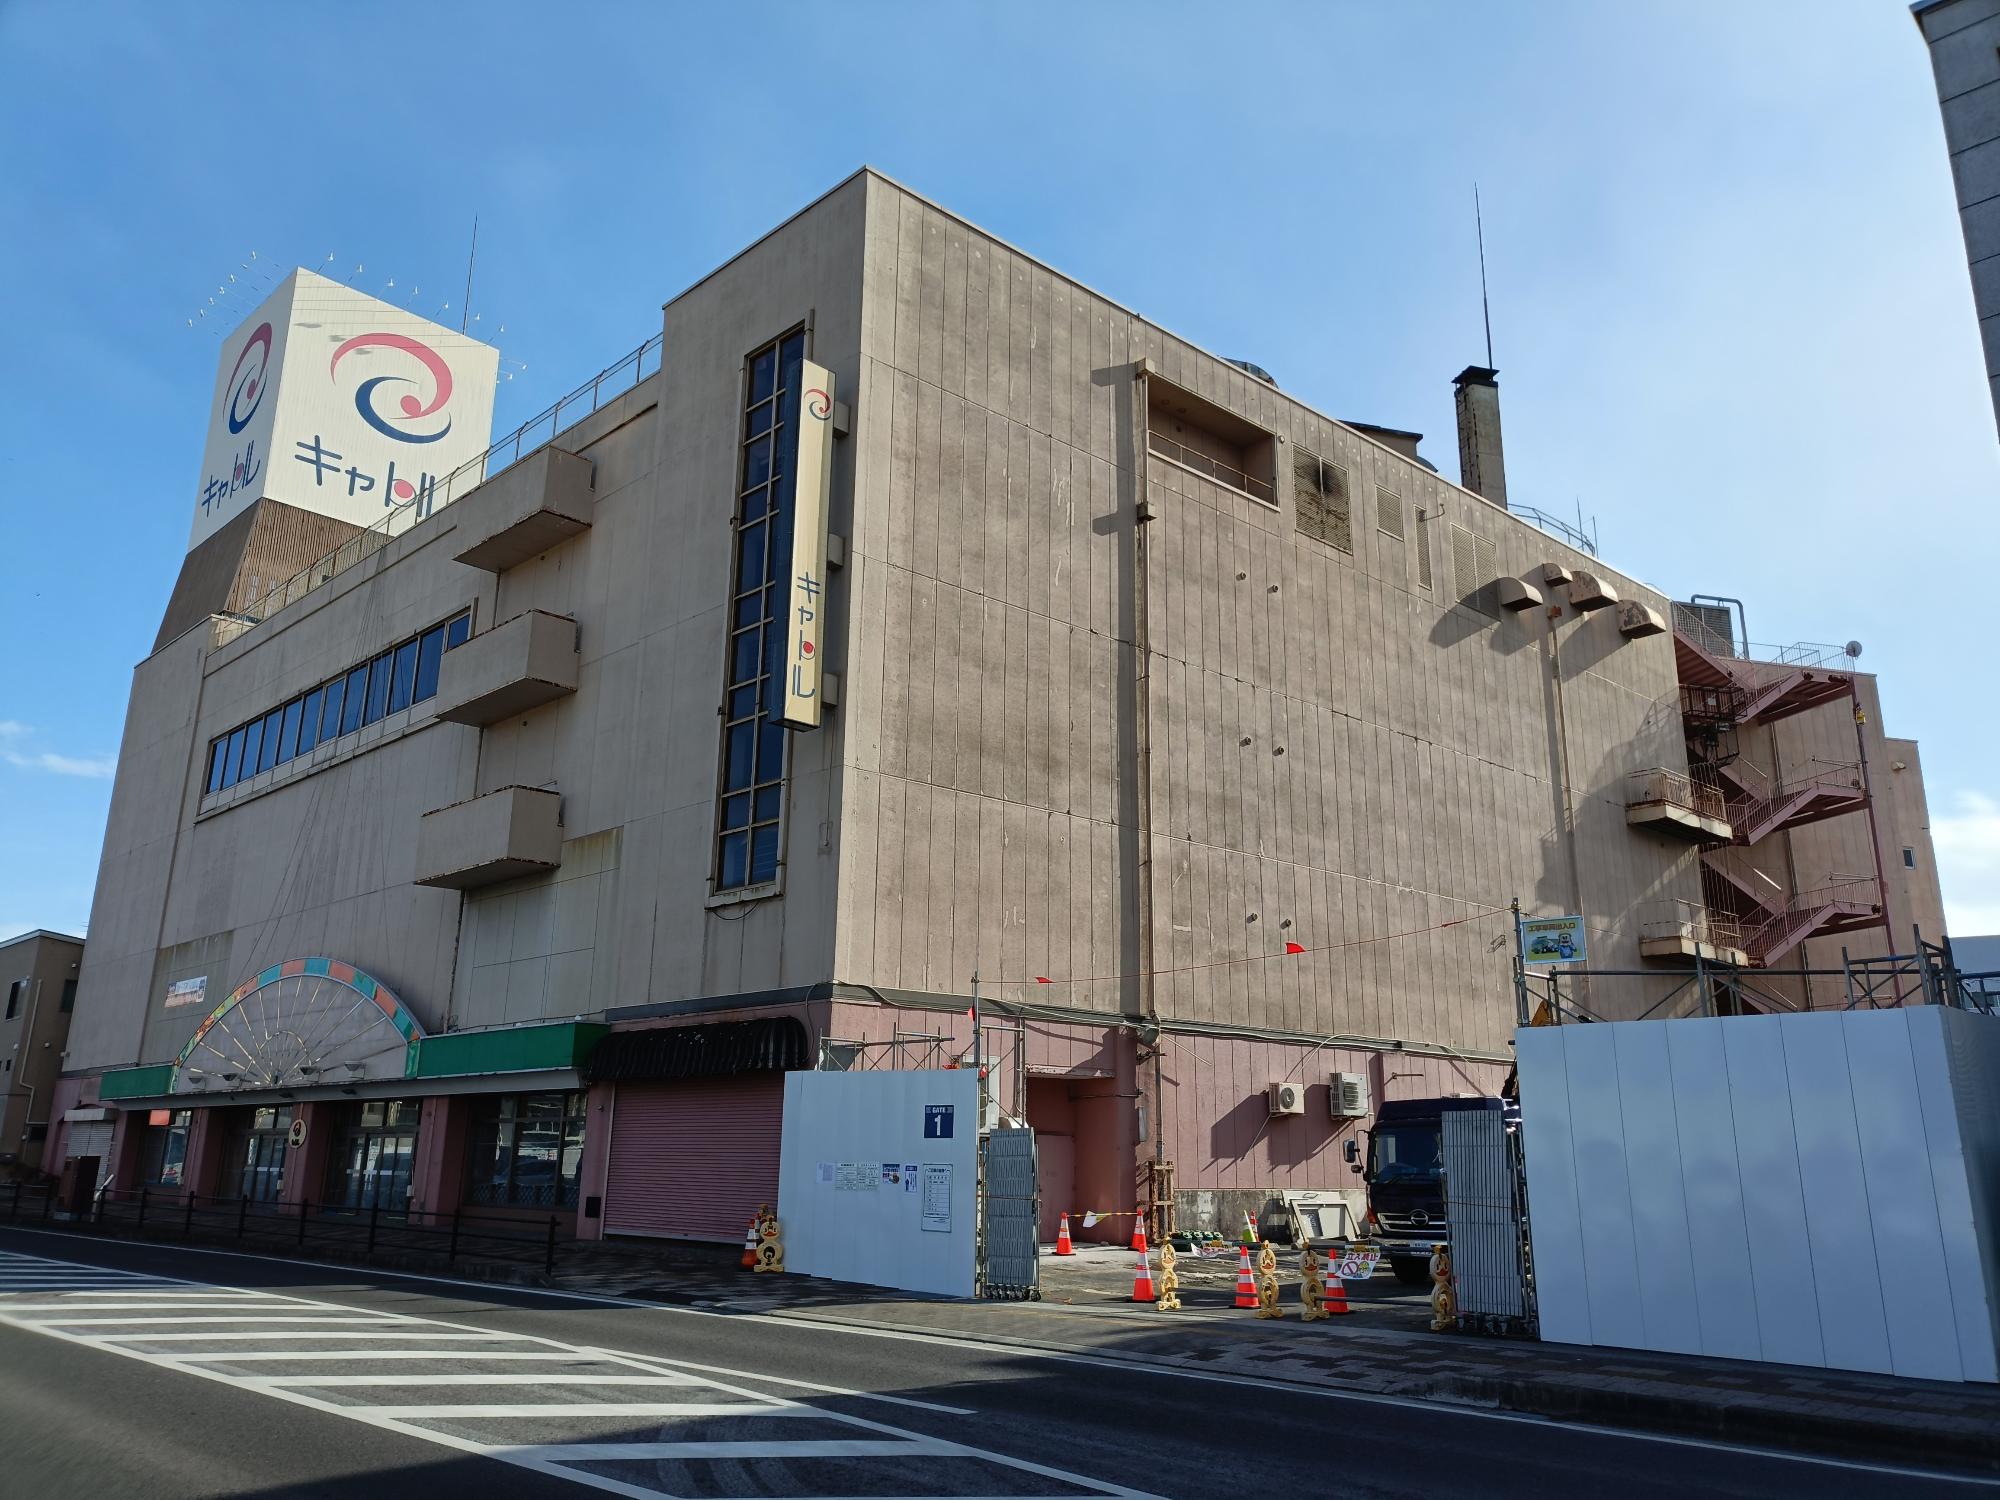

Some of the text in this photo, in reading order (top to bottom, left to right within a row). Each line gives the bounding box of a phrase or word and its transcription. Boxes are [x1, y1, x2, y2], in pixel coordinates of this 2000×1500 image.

[201, 439, 260, 518] キャトル
[791, 571, 820, 698] キャトル
[932, 1106, 946, 1114] GATE
[934, 1114, 942, 1136] 1
